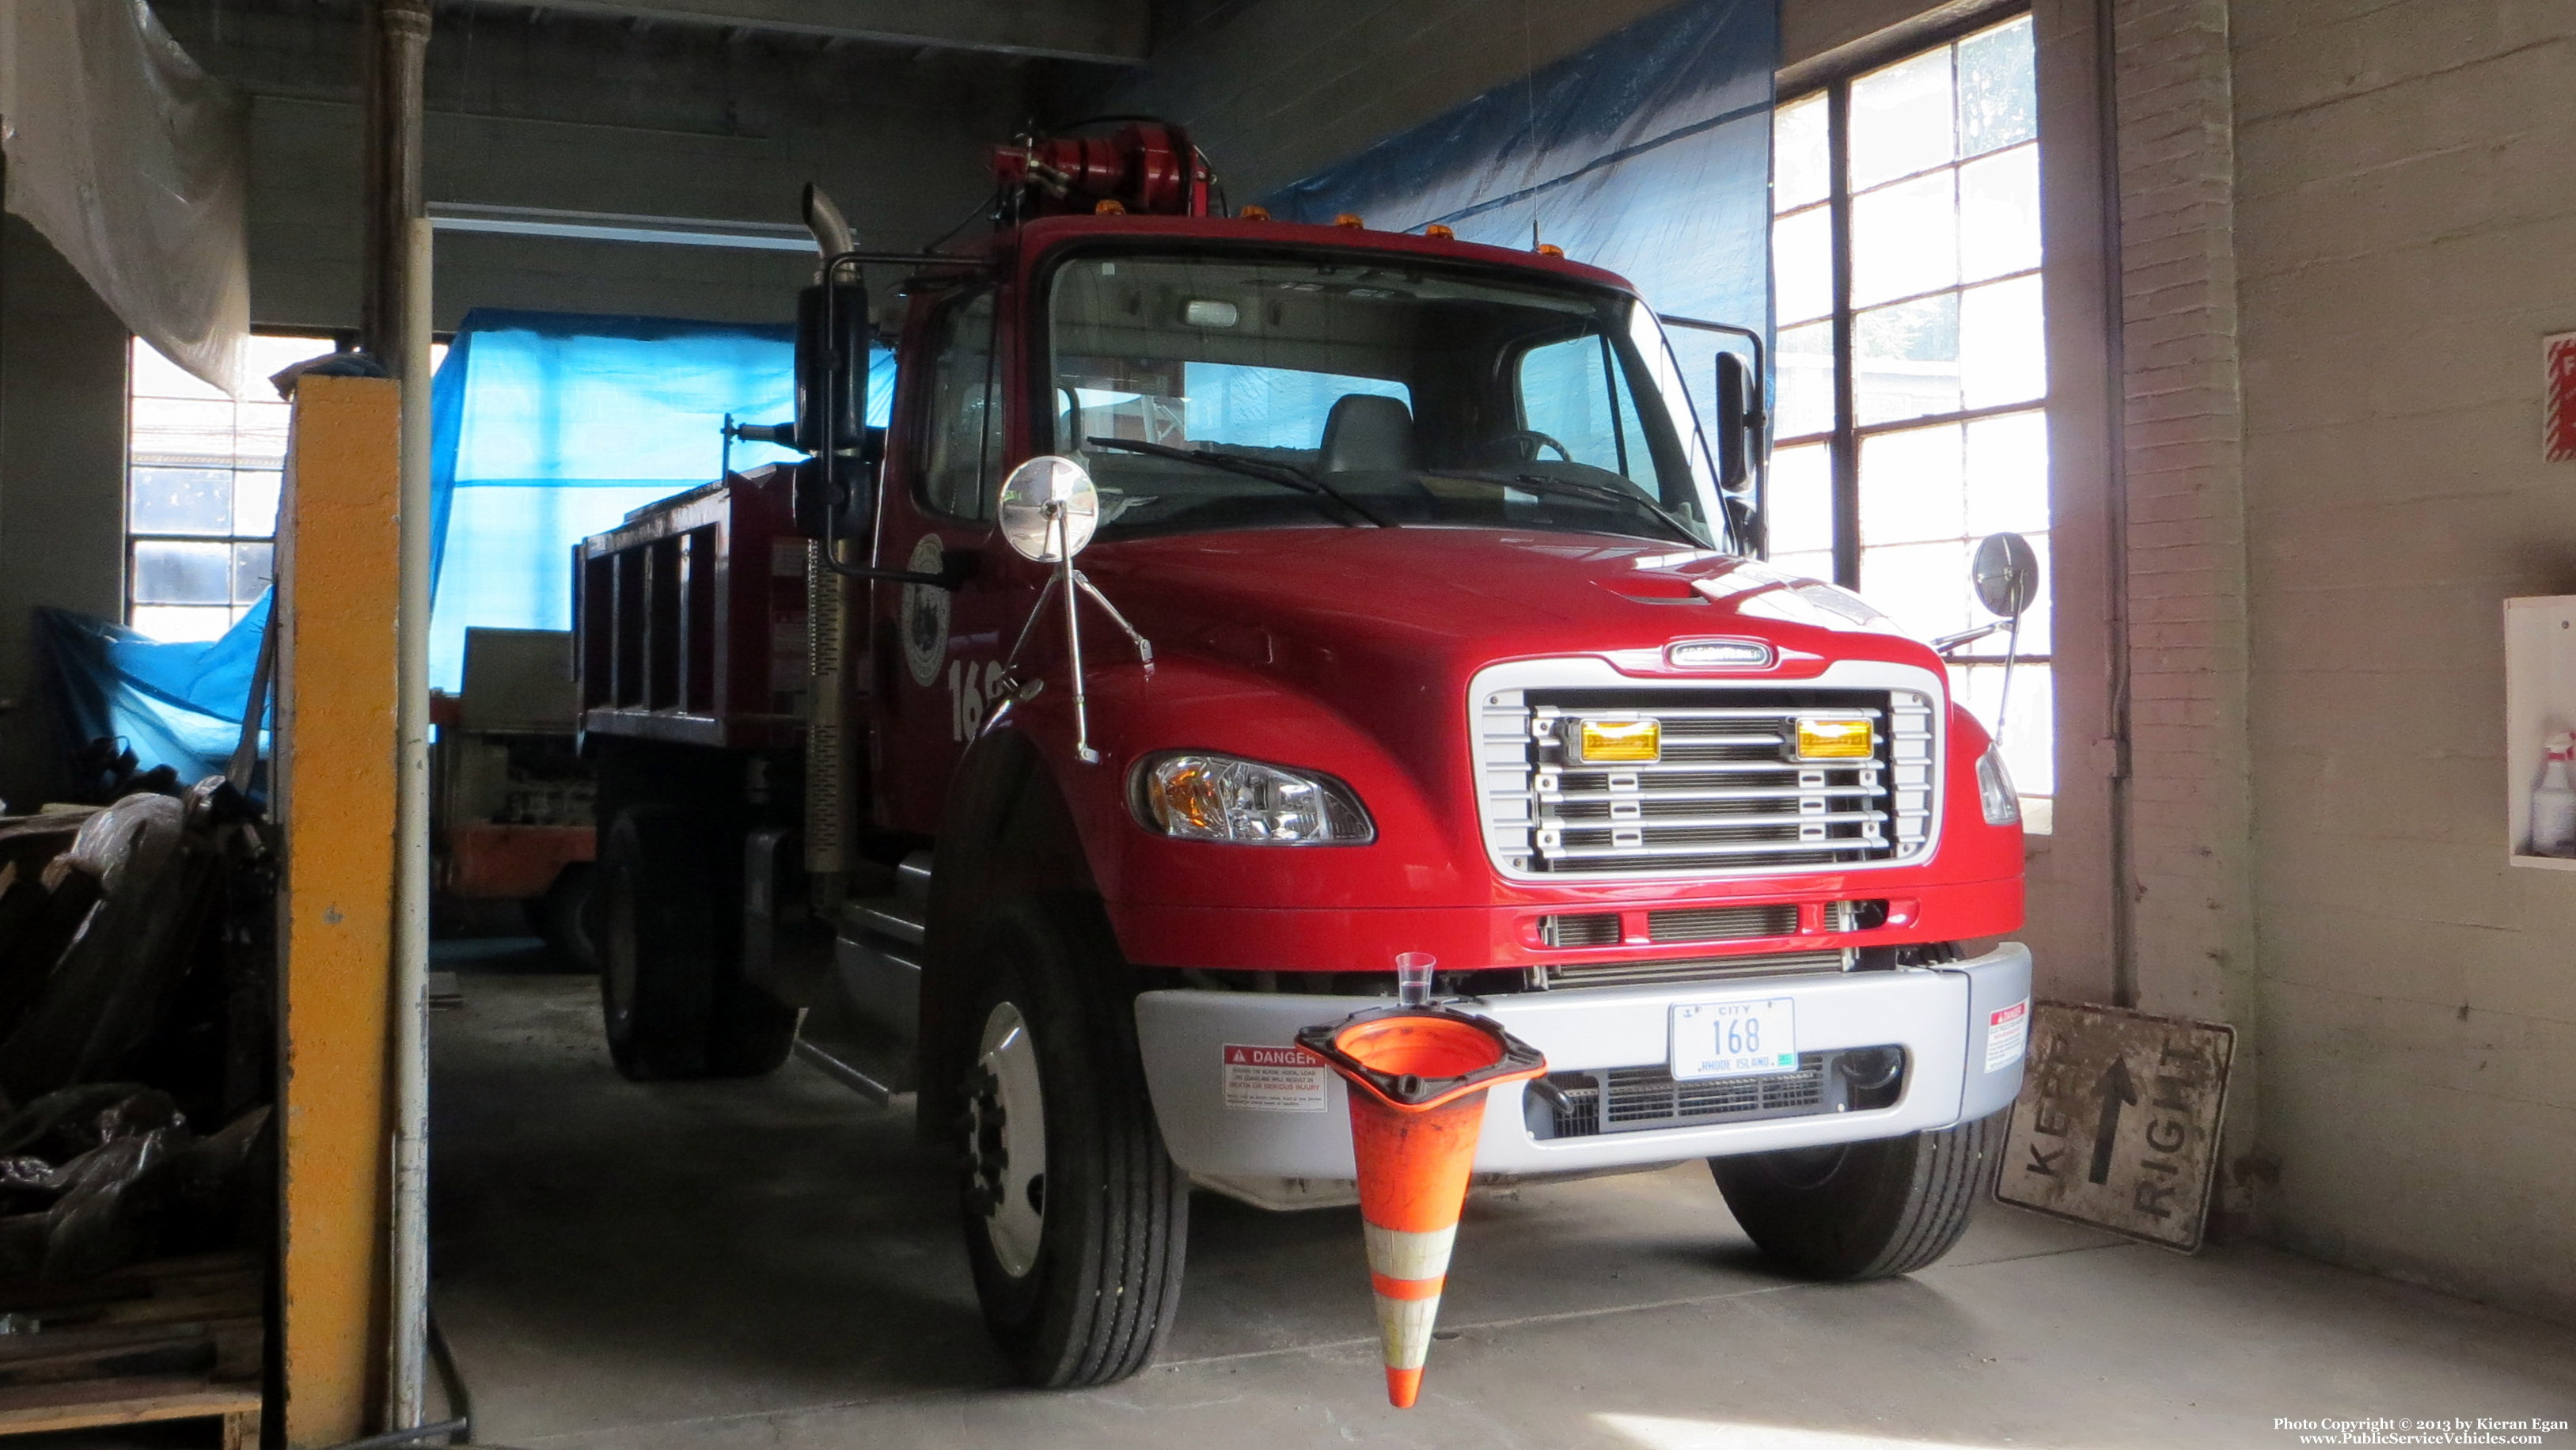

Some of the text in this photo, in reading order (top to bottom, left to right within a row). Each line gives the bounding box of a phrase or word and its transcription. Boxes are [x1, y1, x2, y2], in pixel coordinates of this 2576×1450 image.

[1719, 1005, 1750, 1015] CITY
[1713, 1018, 1759, 1055] 168
[1702, 1058, 1730, 1072] RHODE
[1736, 1056, 1769, 1069] ISLAND
[2026, 1034, 2079, 1178] KEEP
[2133, 1037, 2206, 1219] RIGHT
